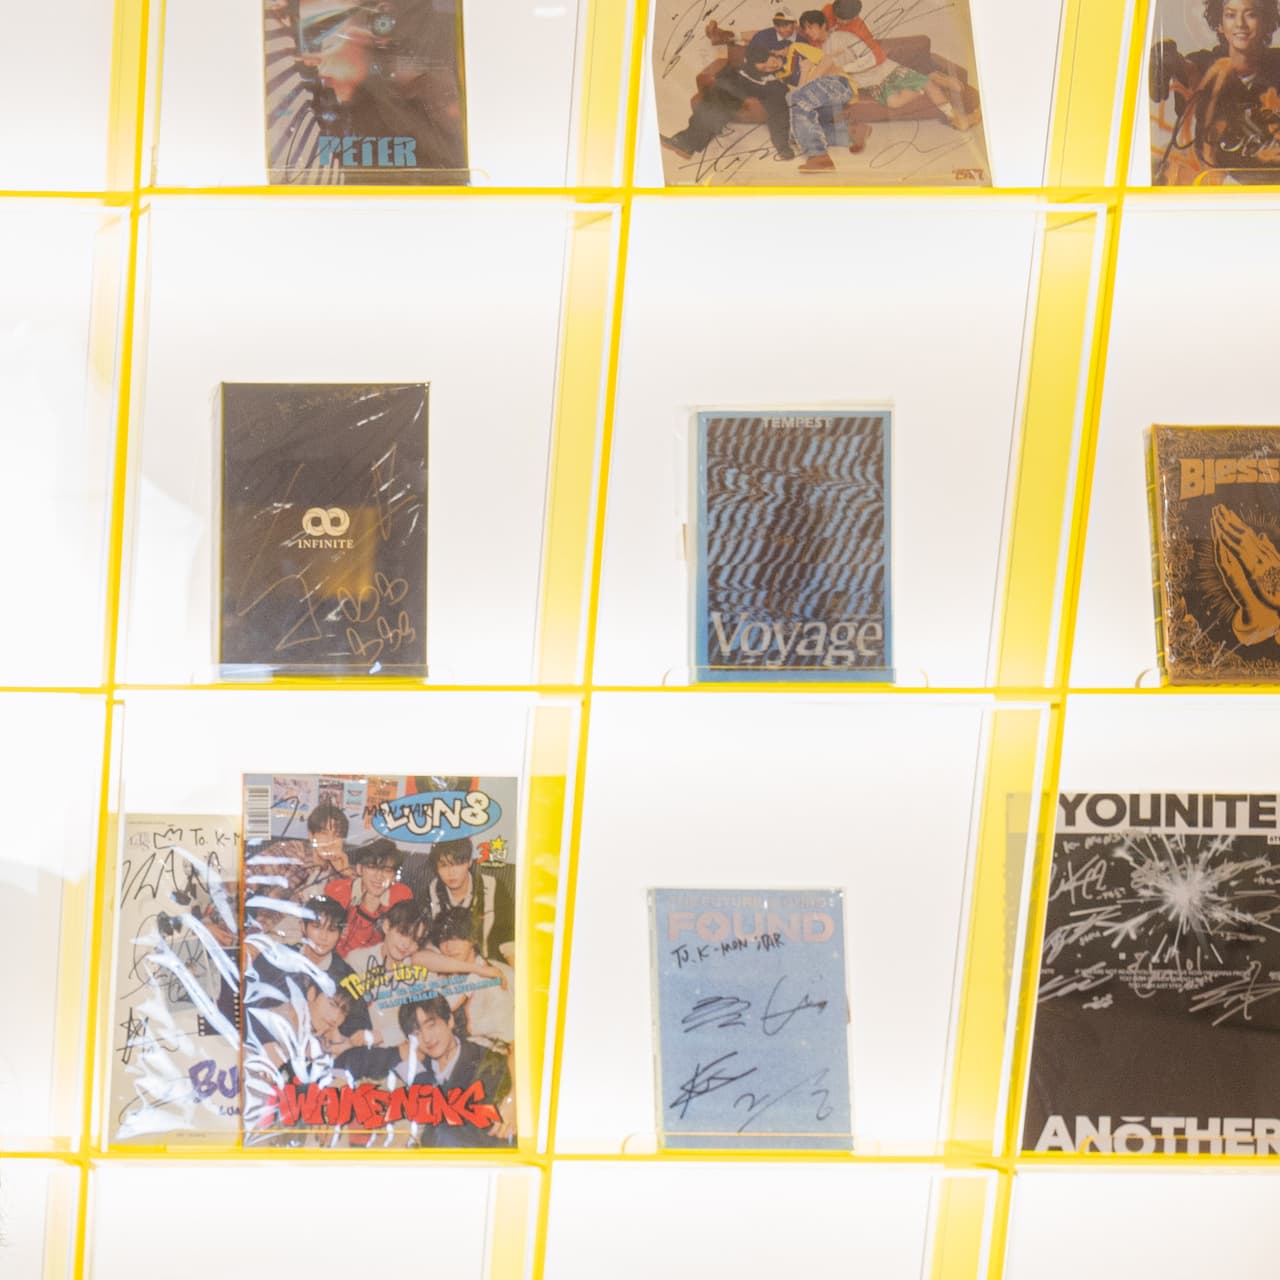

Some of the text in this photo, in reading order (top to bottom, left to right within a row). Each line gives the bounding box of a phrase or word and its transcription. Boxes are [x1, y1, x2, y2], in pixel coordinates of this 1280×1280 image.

[318, 136, 417, 167] PETER
[763, 416, 832, 429] TEMPEST
[298, 539, 354, 549] INFINITE
[710, 611, 884, 667] Voyage
[380, 791, 492, 836] LUN8
[1057, 793, 1278, 829] YOUNITE
[667, 911, 836, 944] FOUND
